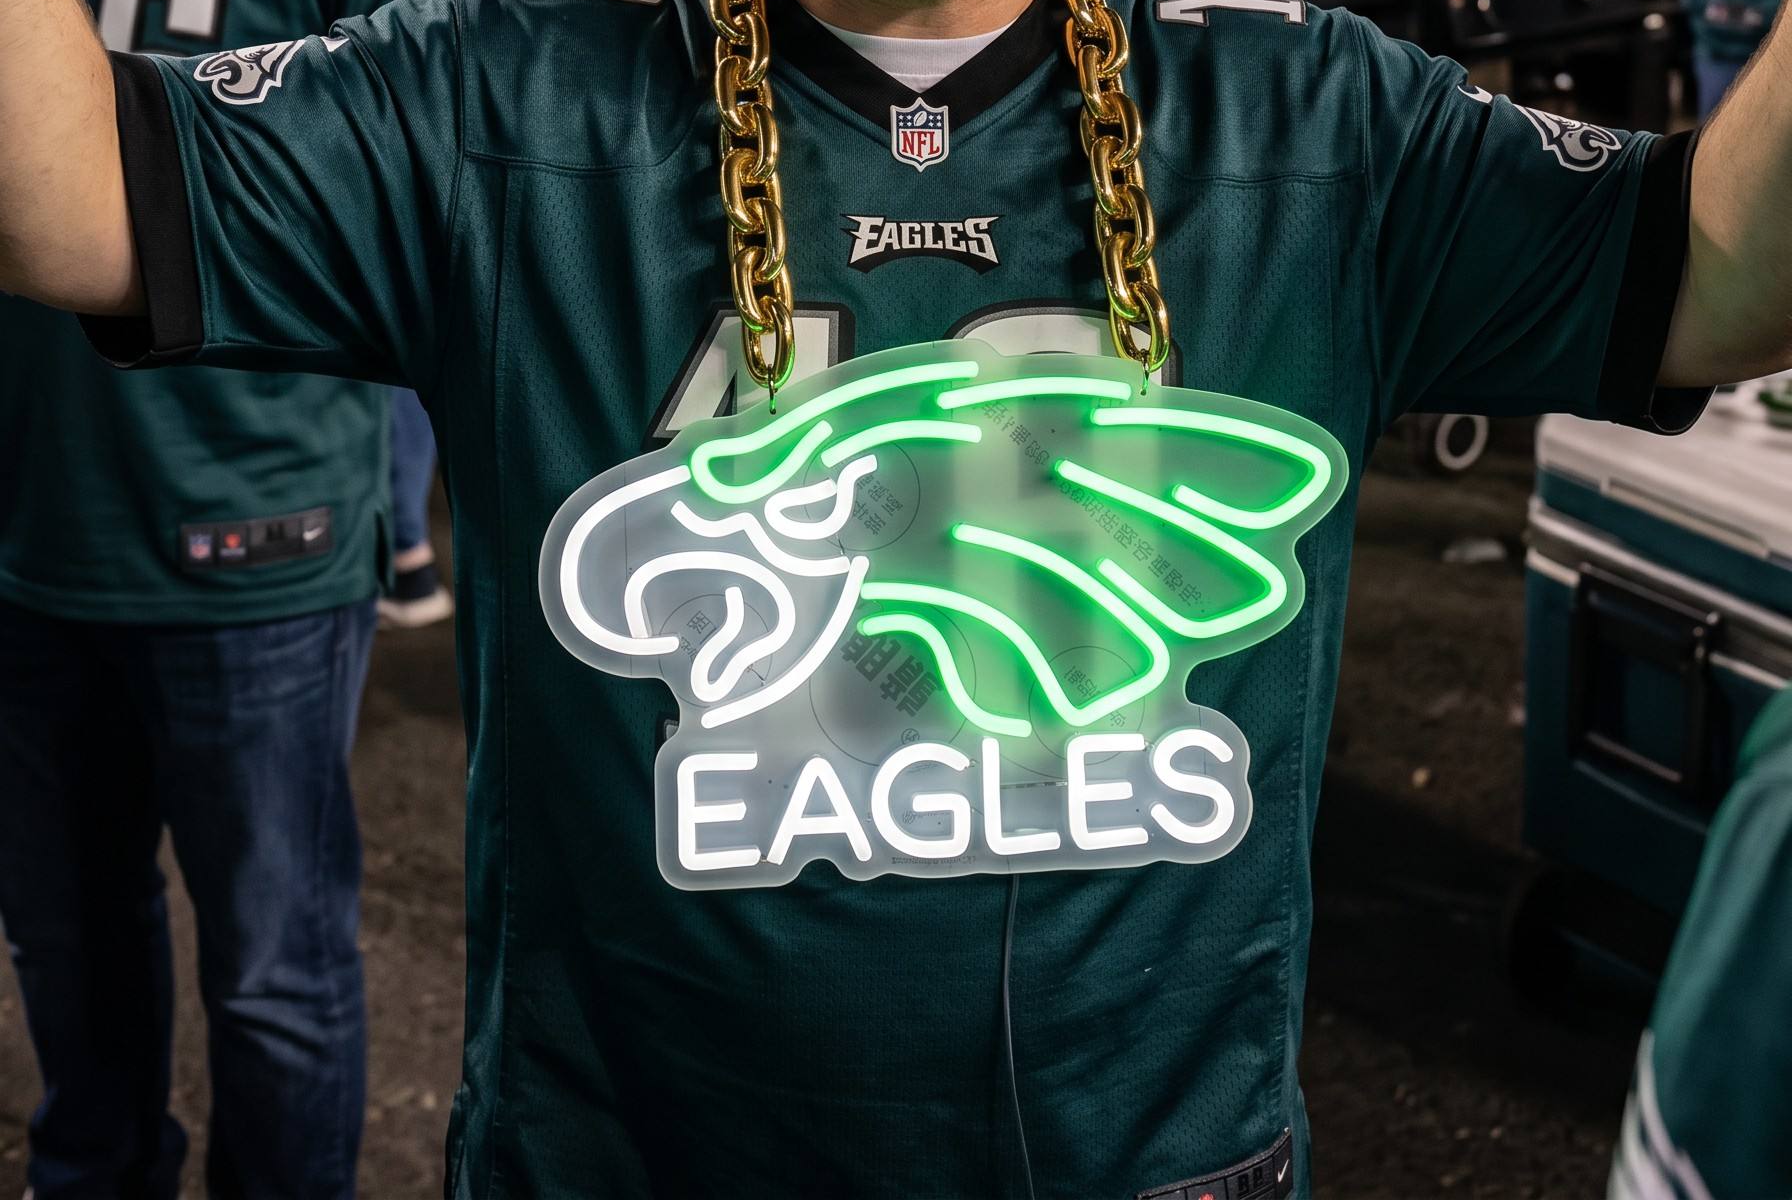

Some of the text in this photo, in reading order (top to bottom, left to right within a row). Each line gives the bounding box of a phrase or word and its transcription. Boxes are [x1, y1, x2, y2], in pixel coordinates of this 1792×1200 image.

[901, 130, 940, 159] NFL
[847, 214, 1000, 264] EAGLES
[677, 728, 1236, 871] EAGLES
